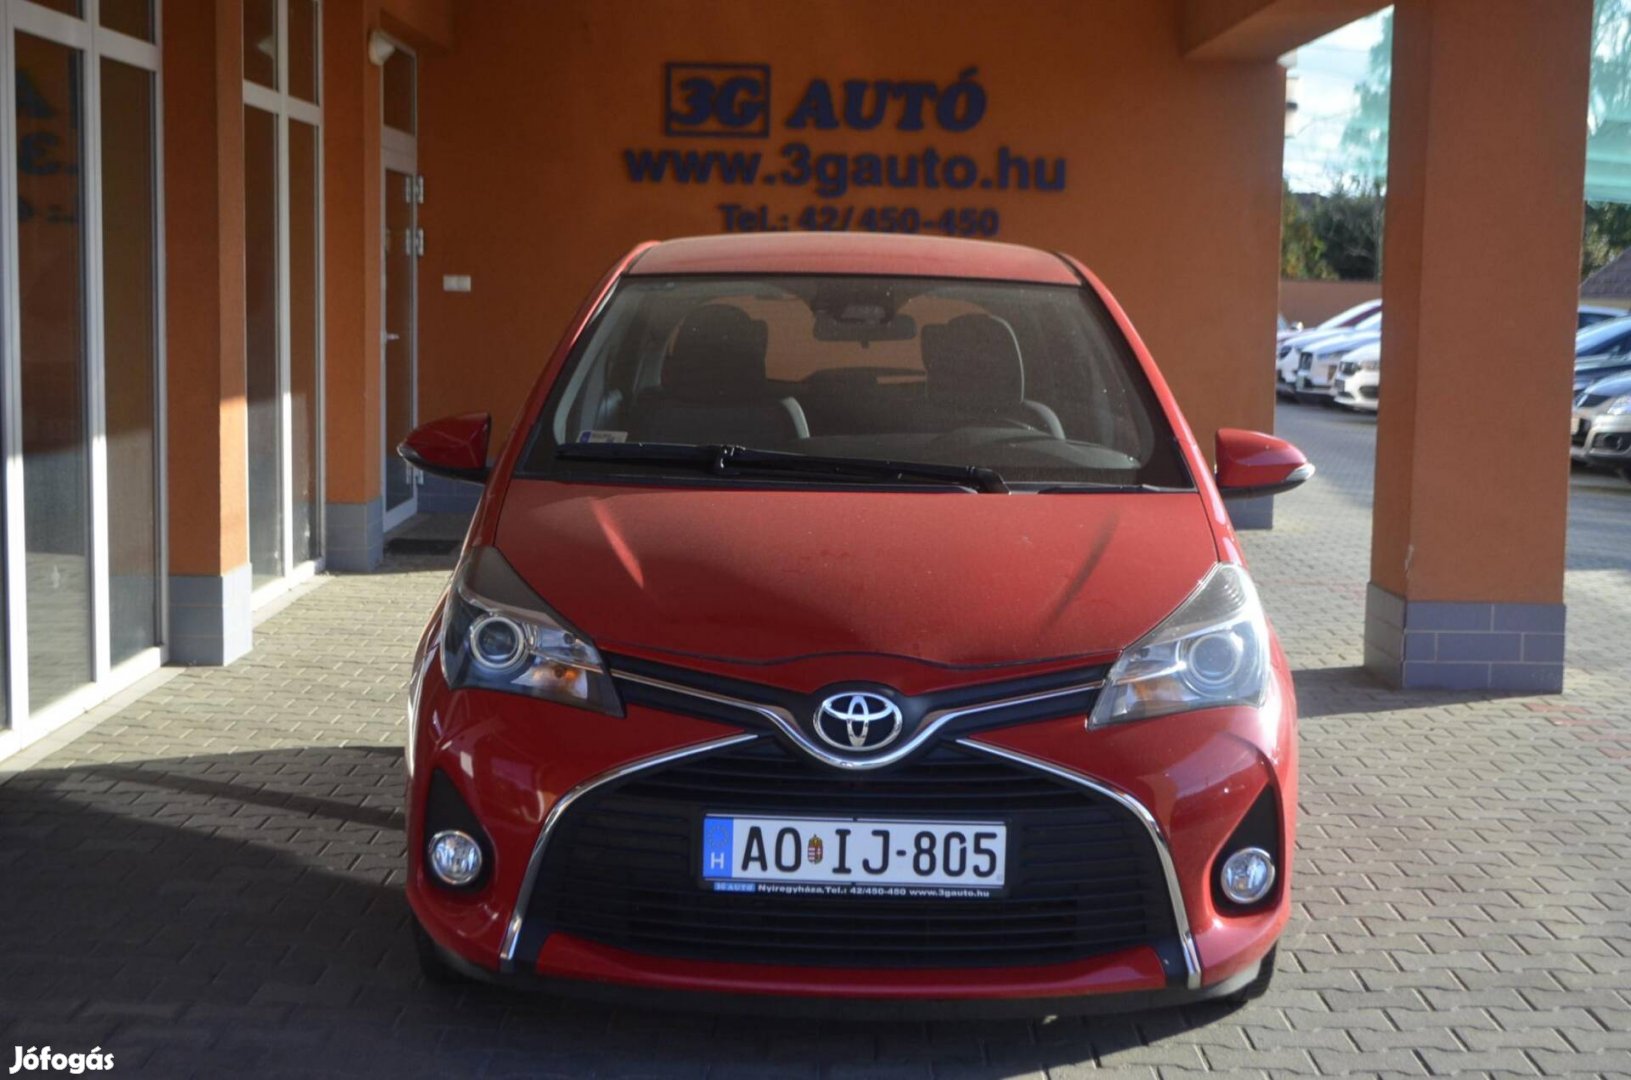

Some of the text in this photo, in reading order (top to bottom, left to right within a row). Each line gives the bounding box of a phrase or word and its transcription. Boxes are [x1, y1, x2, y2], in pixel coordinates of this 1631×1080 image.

[671, 67, 988, 132] 3G AUTÓ
[624, 142, 1067, 198] www.3gauto.hu
[718, 203, 789, 232] Tel.:
[710, 825, 998, 878] H AO IJ-805
